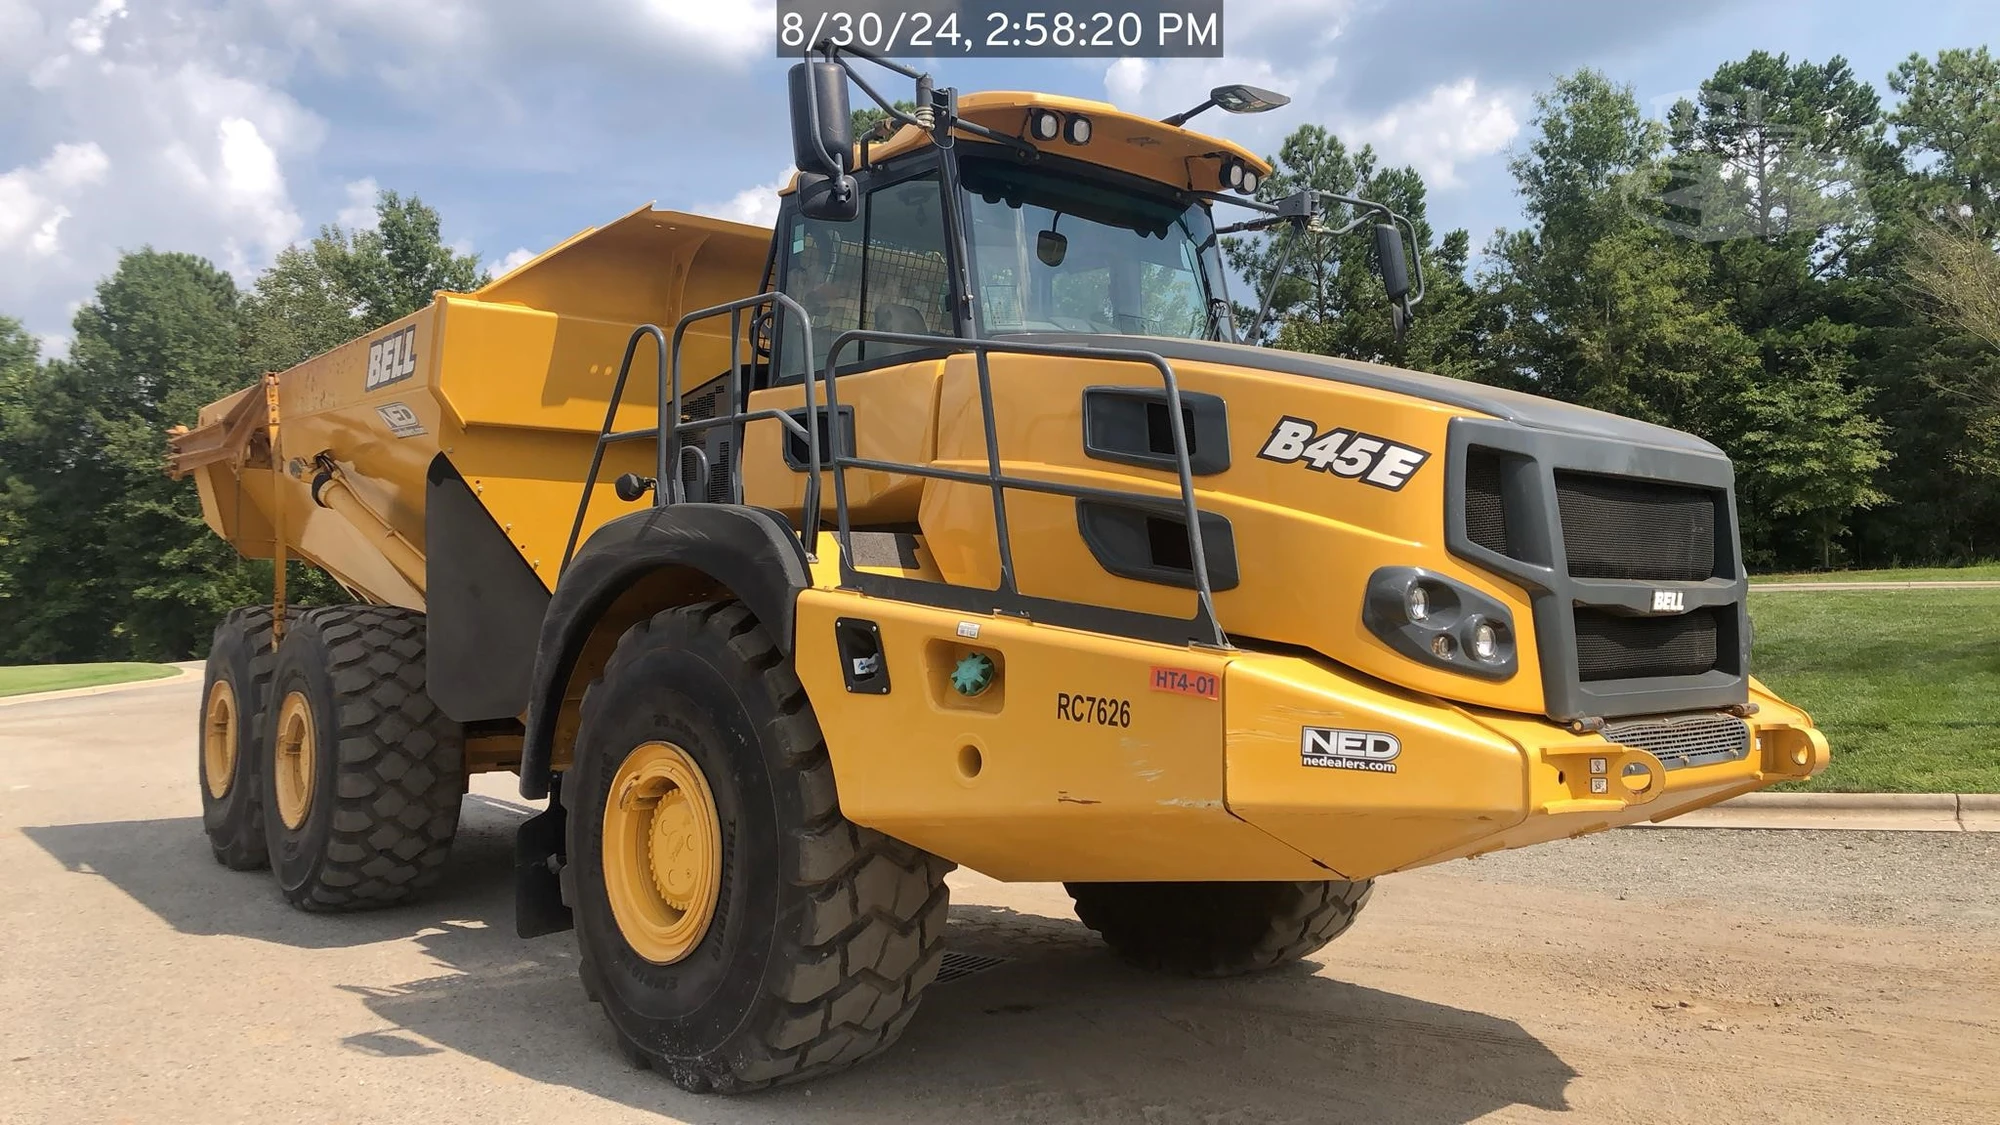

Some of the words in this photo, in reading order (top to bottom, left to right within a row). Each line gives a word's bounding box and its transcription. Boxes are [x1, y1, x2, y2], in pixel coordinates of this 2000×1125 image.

[366, 328, 416, 390] BELL
[1260, 417, 1428, 490] B45E
[1653, 591, 1684, 611] BELL
[1156, 670, 1214, 695] HT4-01
[1057, 693, 1131, 728] RC7626
[1304, 728, 1400, 760] NED
[1303, 756, 1395, 772] nedealers.com
